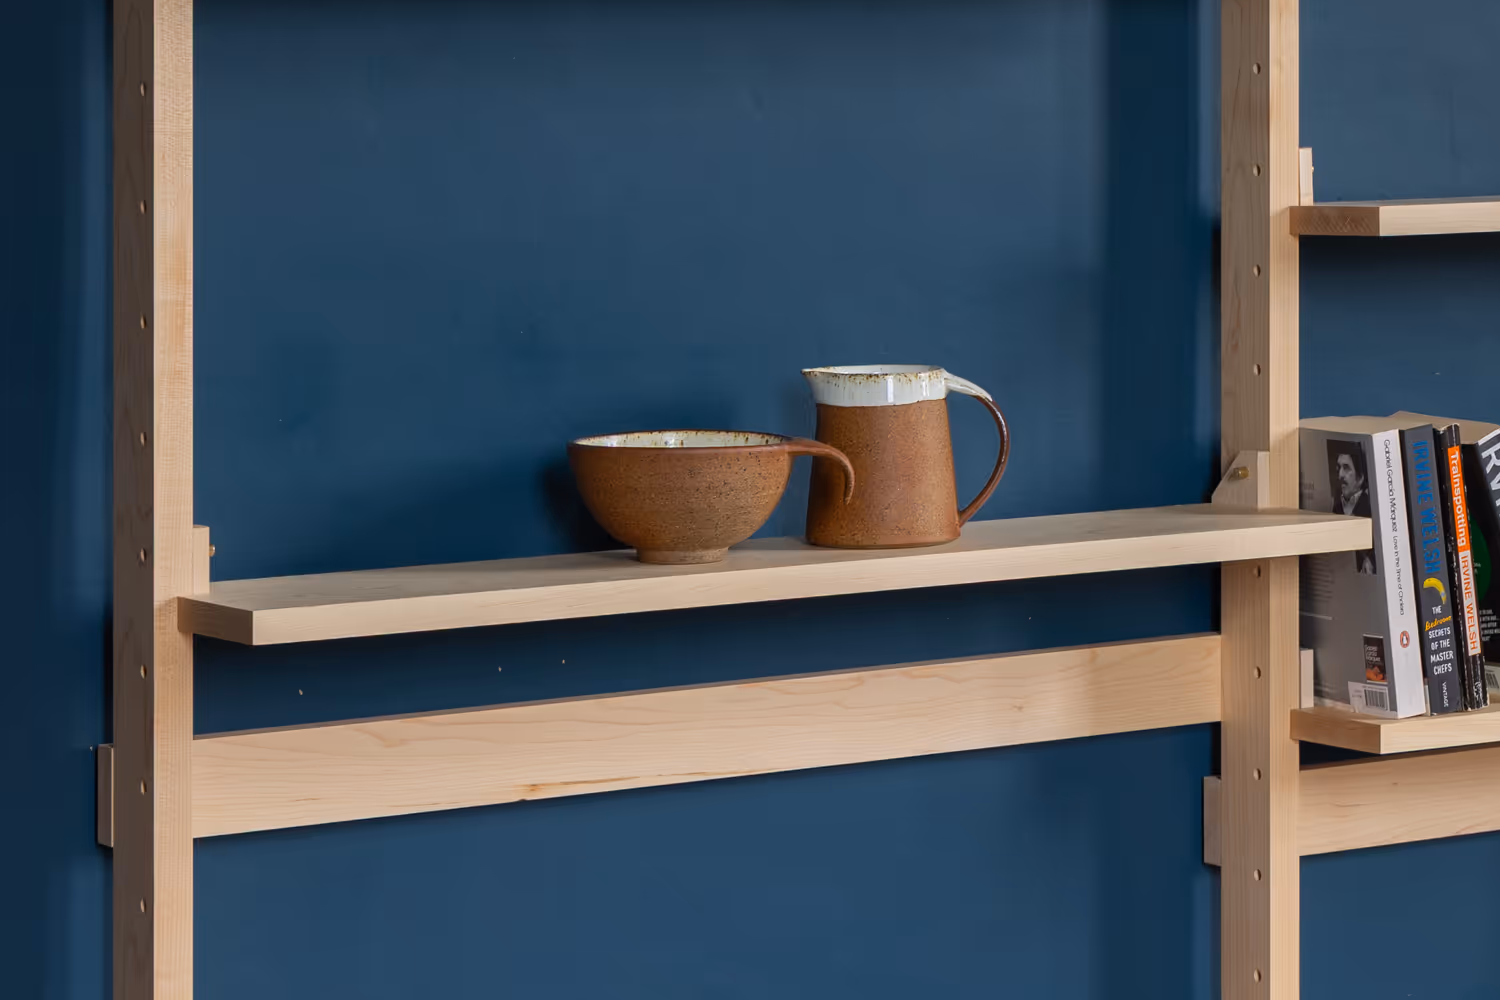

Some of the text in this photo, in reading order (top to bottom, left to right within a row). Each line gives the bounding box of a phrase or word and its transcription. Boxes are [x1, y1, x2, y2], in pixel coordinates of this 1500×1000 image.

[1450, 450, 1467, 547] Trainspotting
[1412, 440, 1441, 574] IRVINE WELSH
[1460, 554, 1479, 650] IRVINE WELSH
[1432, 604, 1442, 615] THE
[1424, 615, 1452, 631] Bedroom
[1428, 626, 1451, 639] SECRETS
[1430, 638, 1451, 651] OF THE
[1430, 650, 1454, 663] MASTER
[1433, 663, 1453, 676] CHEFS
[1441, 681, 1449, 708] VINTAGE
